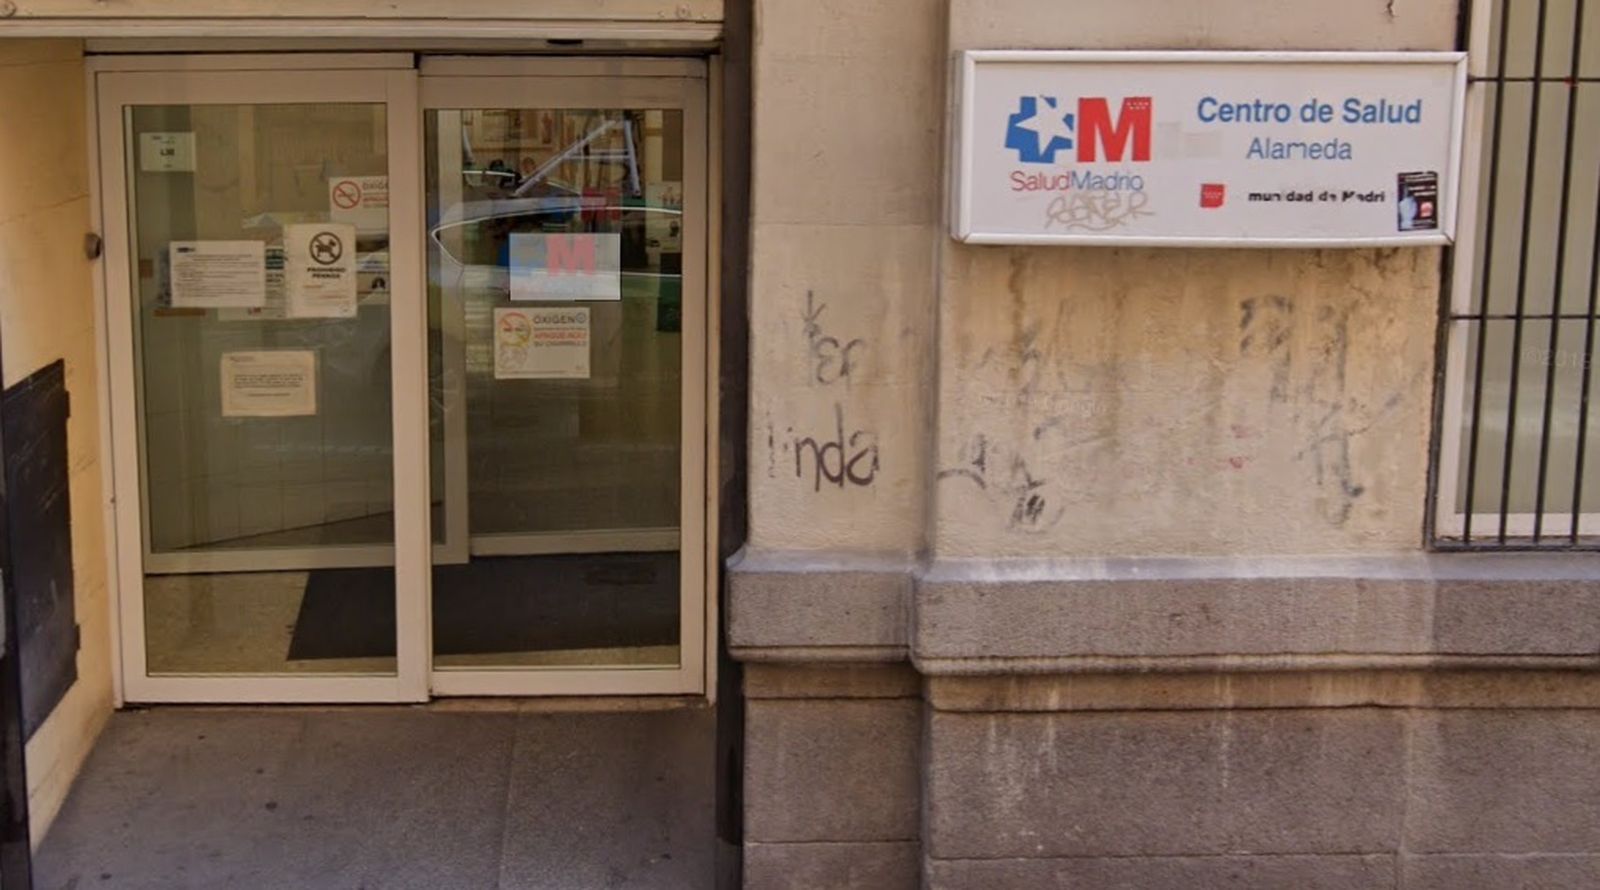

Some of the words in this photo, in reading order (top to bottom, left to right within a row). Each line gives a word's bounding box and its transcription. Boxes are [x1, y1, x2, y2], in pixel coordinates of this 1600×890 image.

[1197, 96, 1291, 123] Centro
[1300, 98, 1334, 123] de
[1342, 98, 1422, 124] Salud
[1077, 96, 1152, 163] M
[1246, 136, 1352, 160] Alameda
